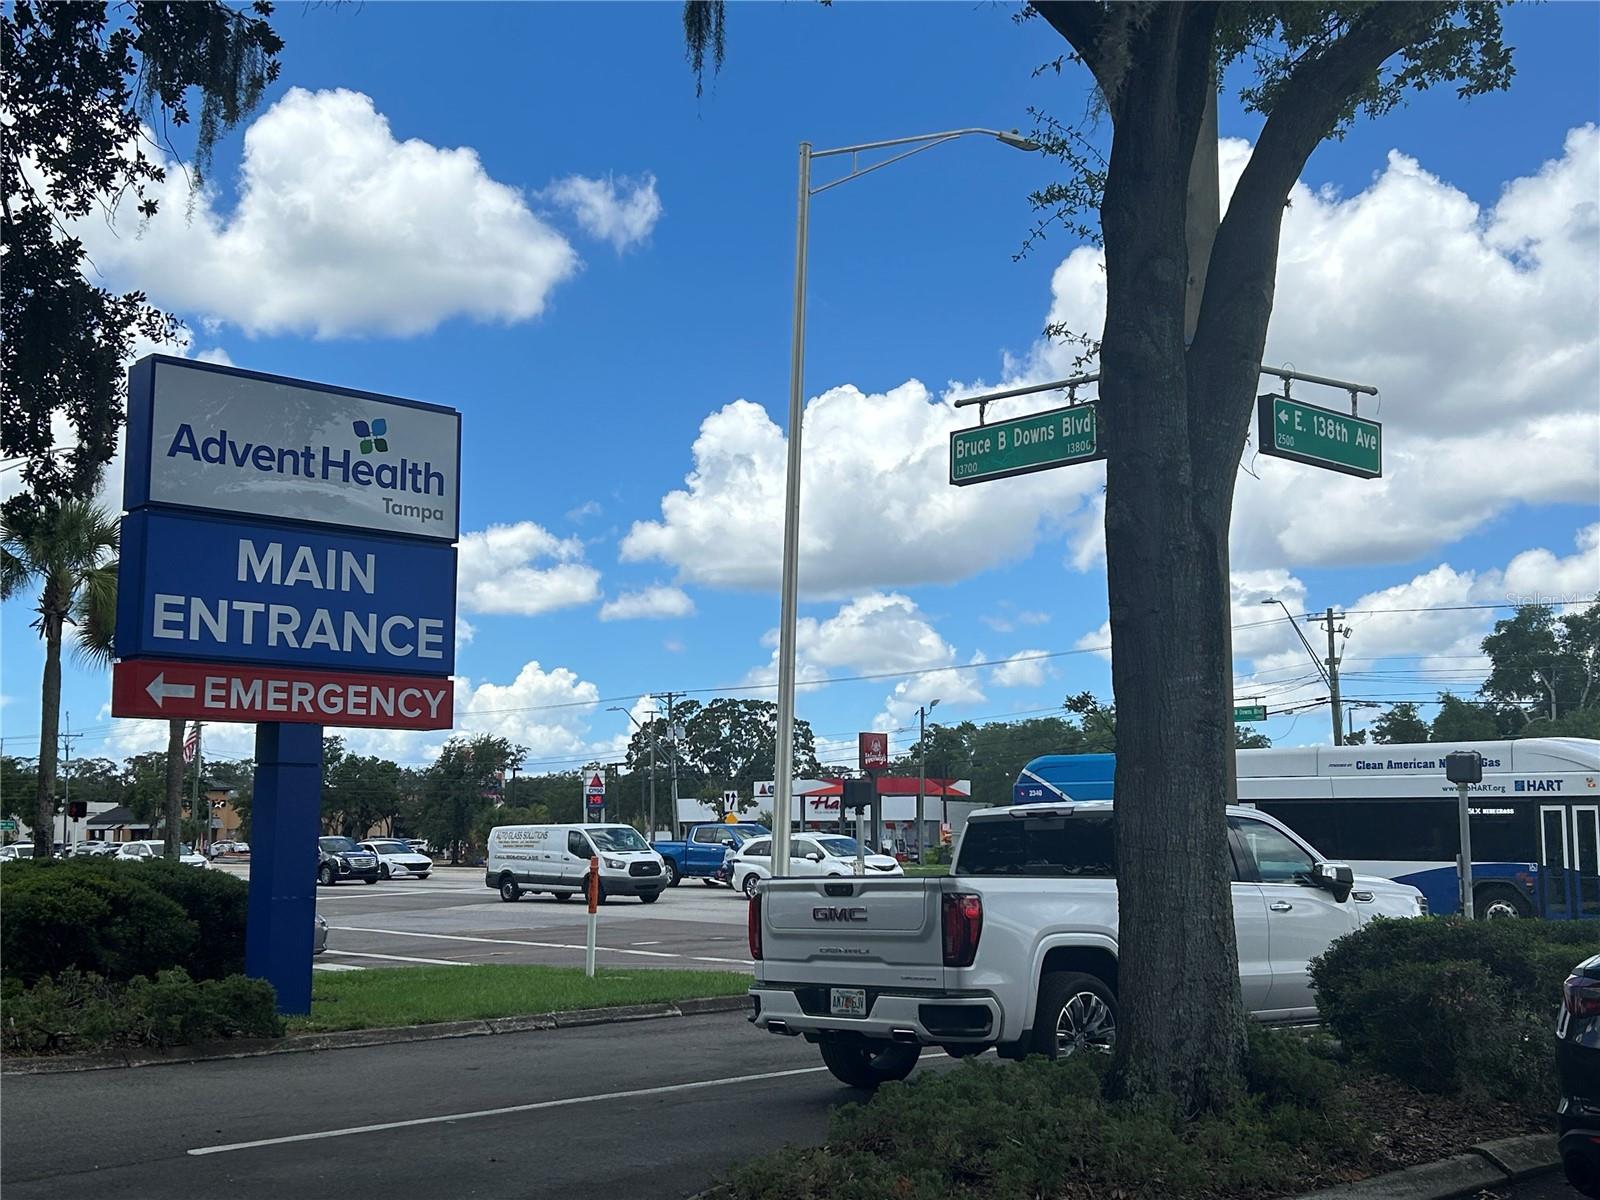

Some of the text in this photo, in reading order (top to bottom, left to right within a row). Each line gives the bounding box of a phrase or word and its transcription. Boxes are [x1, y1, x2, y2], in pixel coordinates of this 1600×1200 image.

[956, 413, 1091, 459] Bruce B Downs Blvd
[1278, 433, 1295, 447] 2500
[1294, 410, 1377, 450] E. 138th Ave
[167, 422, 445, 497] AdventHealth
[956, 462, 978, 475] 13700
[382, 497, 445, 523] Tampa
[237, 538, 376, 594] MAIN
[152, 593, 445, 659] ENTRANCE
[204, 675, 447, 719] EMERGENCY
[1356, 760, 1384, 770] Clean
[1387, 758, 1435, 770] American
[1481, 757, 1501, 768] Gas
[1527, 779, 1563, 792] HART
[812, 906, 868, 922] GMC
